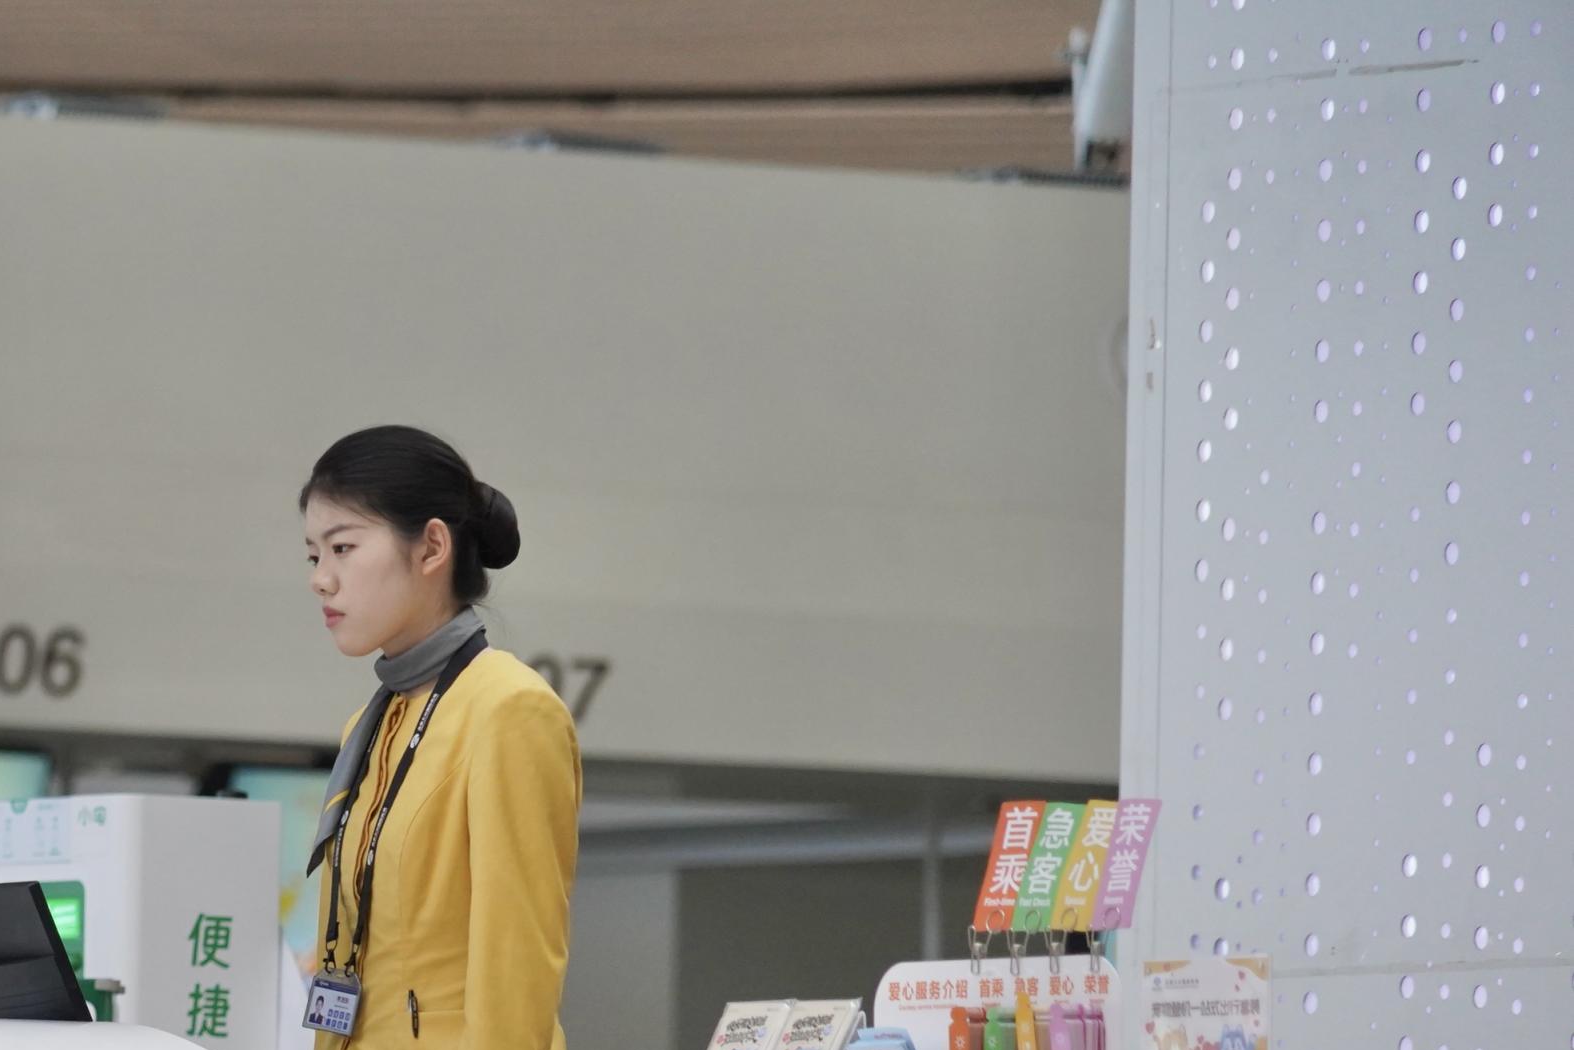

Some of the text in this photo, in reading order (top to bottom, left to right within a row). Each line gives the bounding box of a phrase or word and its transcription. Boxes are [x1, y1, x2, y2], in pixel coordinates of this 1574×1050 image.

[989, 806, 1039, 895] 首乘
[1028, 807, 1076, 895] 急客
[1067, 807, 1118, 892] 爱心
[1106, 804, 1152, 892] 荣誉
[186, 912, 233, 1038] 便捷
[887, 979, 968, 1001] 爱心服务介绍
[979, 977, 1004, 998] 首乘
[1048, 975, 1075, 996] 爱心
[1084, 974, 1110, 994] 荣誉
